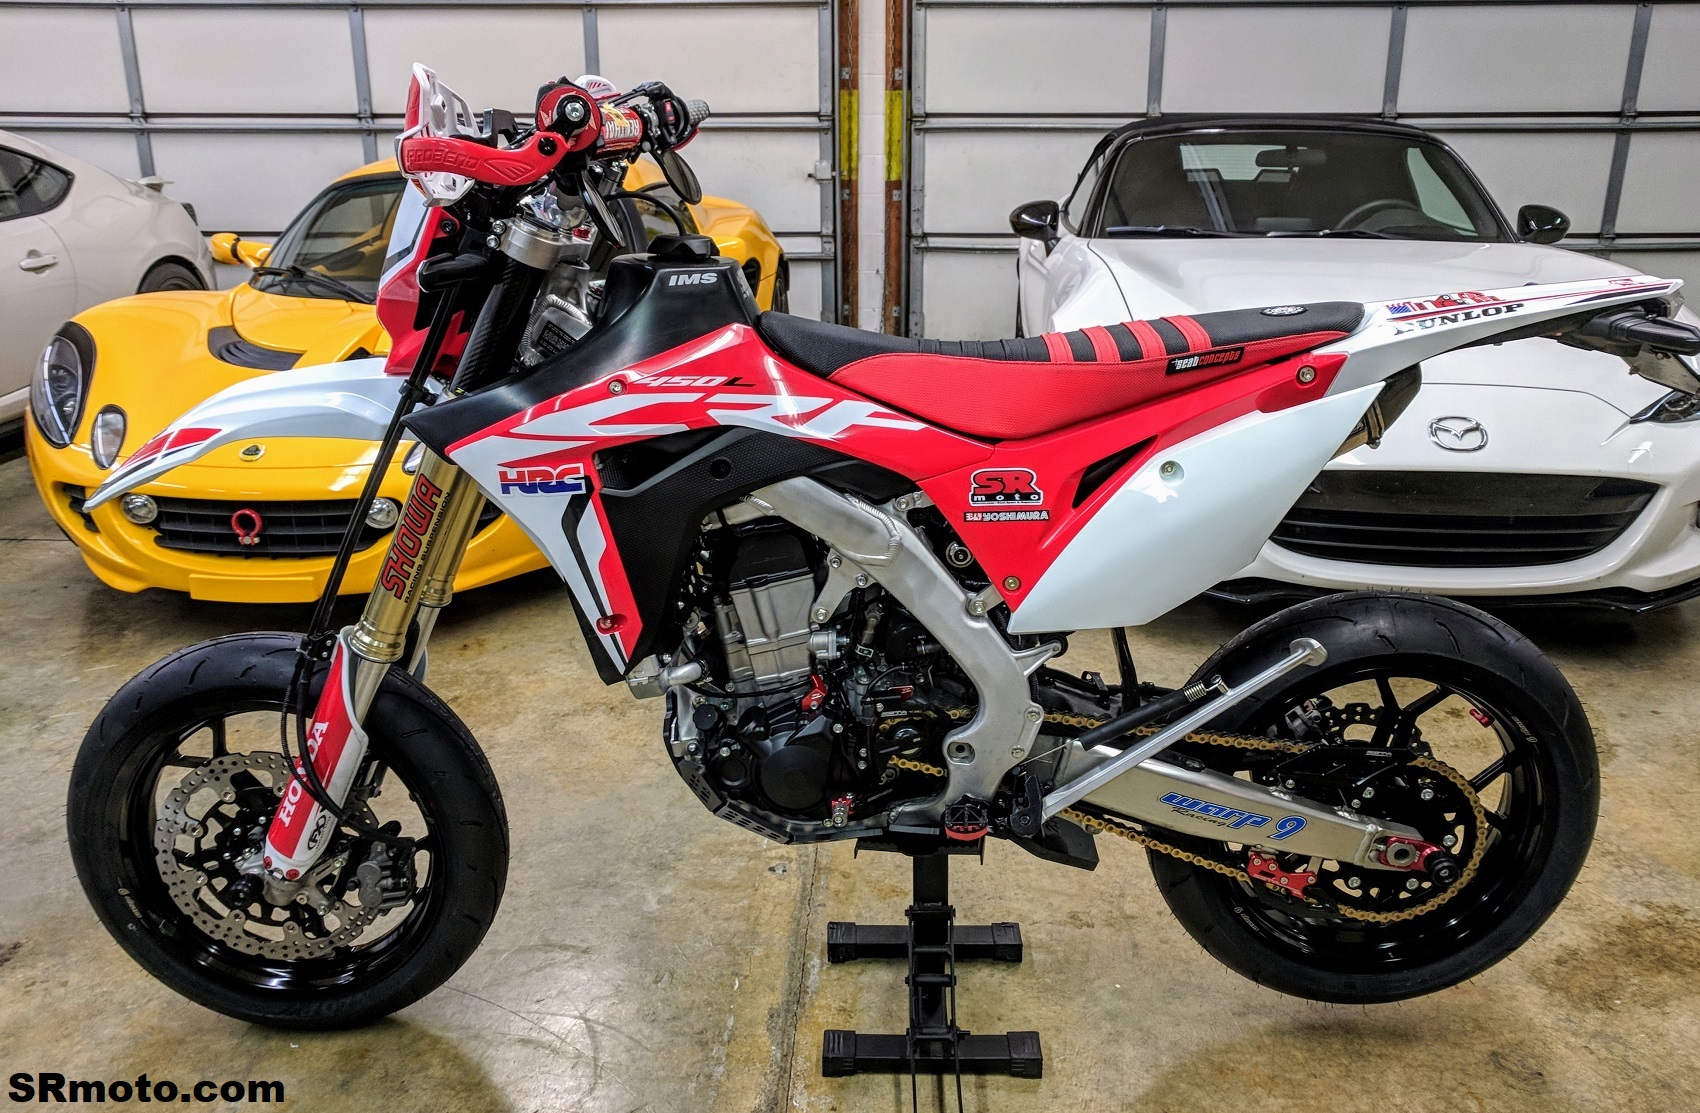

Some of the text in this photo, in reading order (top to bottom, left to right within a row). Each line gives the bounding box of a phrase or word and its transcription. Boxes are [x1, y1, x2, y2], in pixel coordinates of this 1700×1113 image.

[669, 273, 718, 286] IMS
[509, 393, 928, 440] CRF
[499, 466, 586, 495] HRC
[973, 470, 1037, 494] SR
[983, 510, 1049, 521] YOSHIMURA
[381, 473, 443, 600] SHOWA
[404, 491, 451, 604] RACING SUSPENSION
[1160, 791, 1308, 841] warp 9
[1170, 806, 1227, 827] Racing
